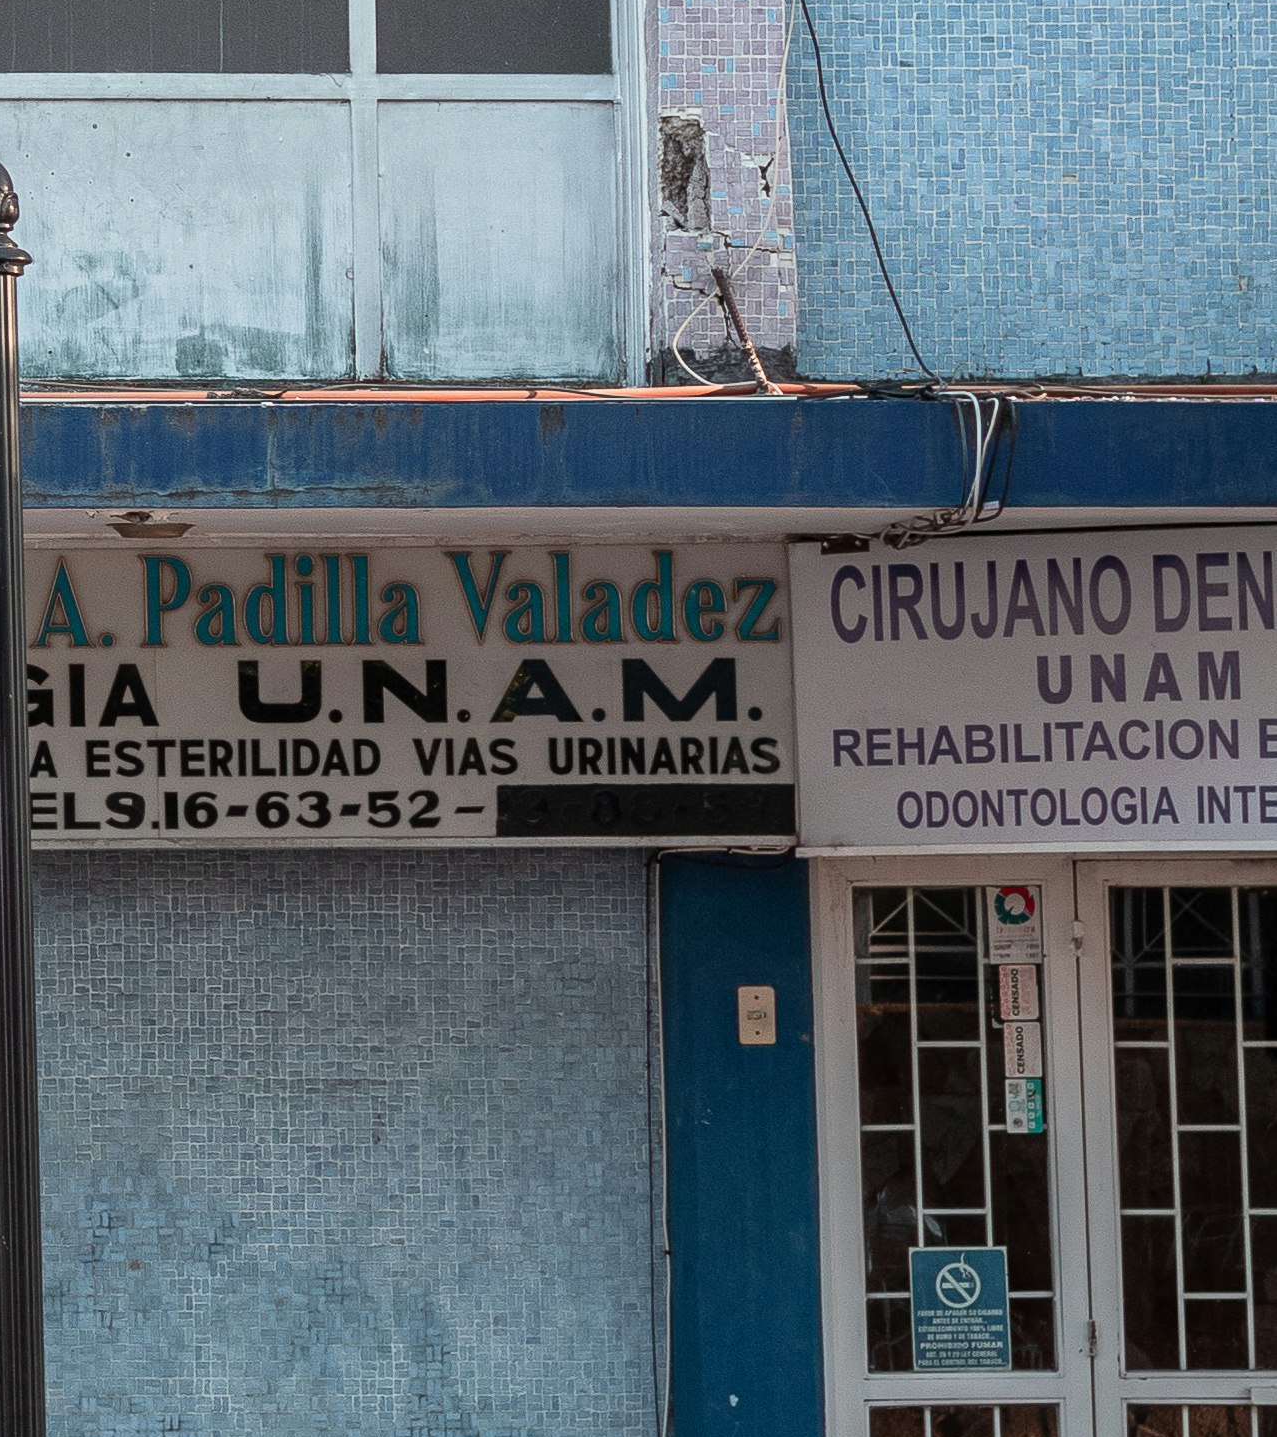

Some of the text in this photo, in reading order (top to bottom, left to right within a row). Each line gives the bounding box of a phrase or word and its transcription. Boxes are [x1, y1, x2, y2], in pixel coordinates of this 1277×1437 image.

[30, 554, 116, 649] A.
[138, 551, 425, 649] Padilla
[446, 549, 782, 645] Valadez
[830, 555, 1132, 643] CIRUJANO
[237, 658, 763, 724] U.N.A.M.
[85, 738, 381, 778] ESTERILIDAD
[413, 737, 518, 776] VIAS
[548, 737, 780, 776] URINARIAS
[833, 718, 1240, 767] REHABILITACION
[897, 786, 1180, 829] ODONTOLOGIA
[1011, 968, 1020, 1017] CENSADO
[1015, 1026, 1025, 1075] CENSADO
